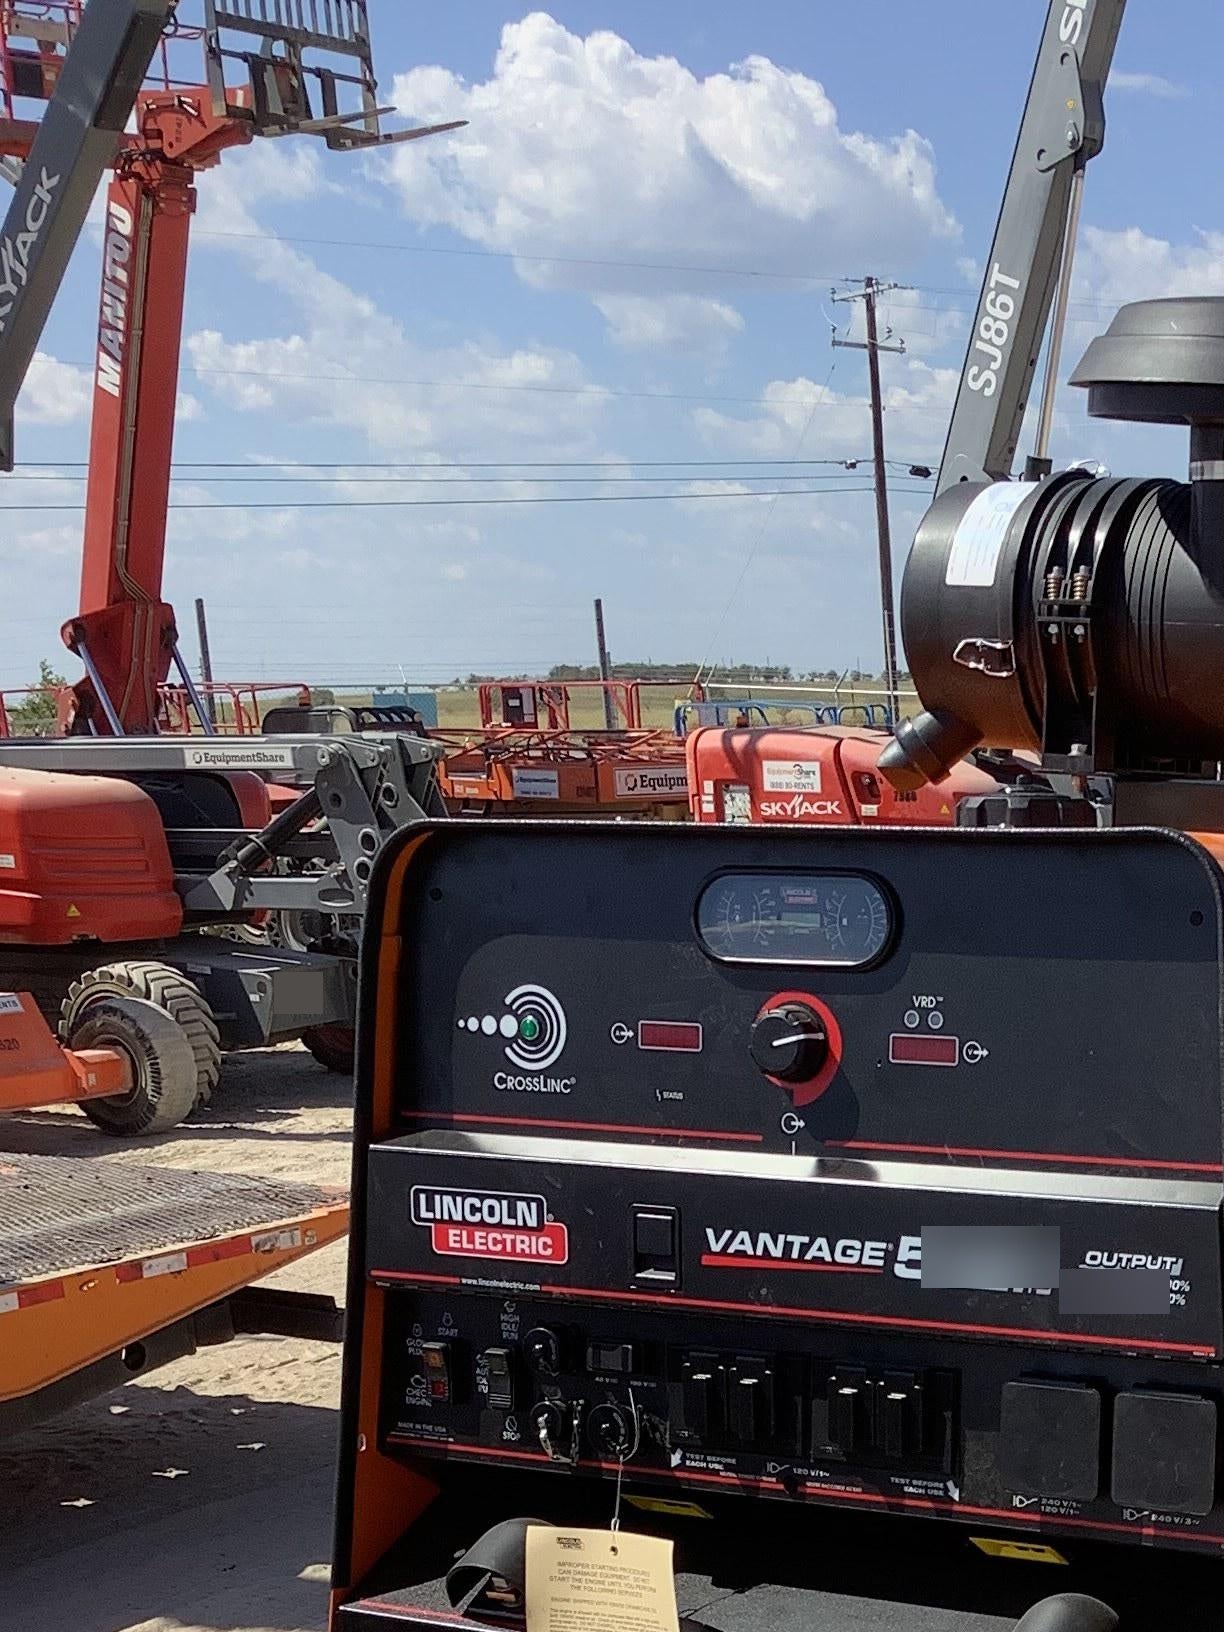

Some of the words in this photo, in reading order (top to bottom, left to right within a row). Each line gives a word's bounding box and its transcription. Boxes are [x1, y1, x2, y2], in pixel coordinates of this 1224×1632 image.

[97, 201, 135, 398] MANITOU
[967, 262, 1021, 398] SJ86T
[203, 752, 285, 765] EquipmentShare
[760, 794, 842, 819] SKYJACK
[419, 1193, 538, 1228] LINCOLN
[448, 1228, 553, 1257] ELECTRIC
[705, 1227, 888, 1267] VANTAGE
[1085, 1250, 1177, 1270] OUTPUT
